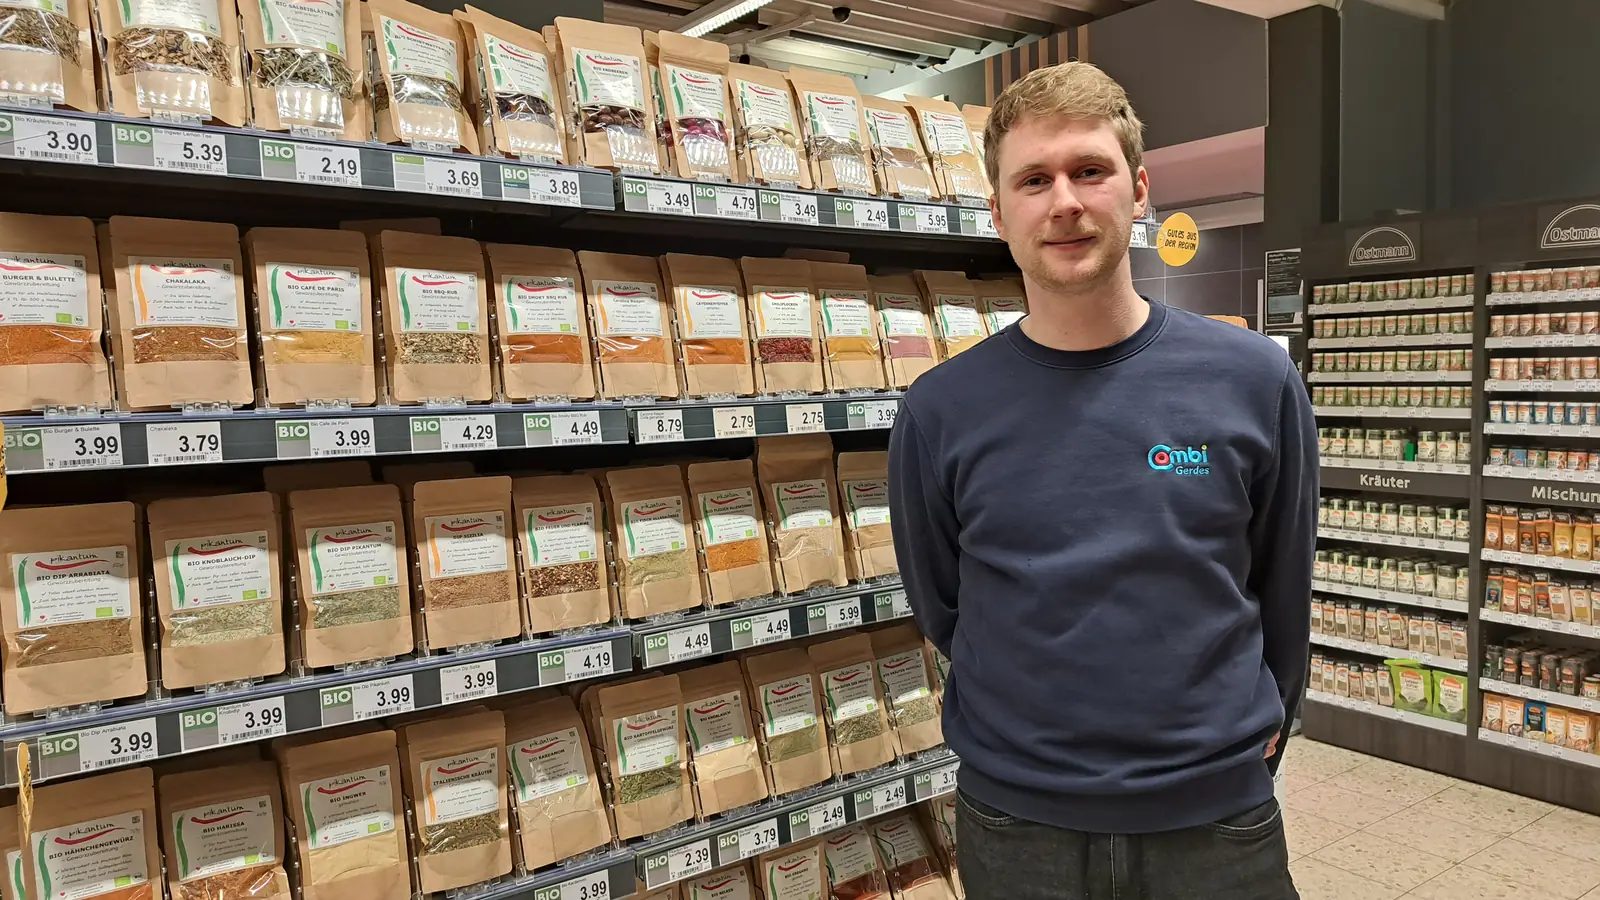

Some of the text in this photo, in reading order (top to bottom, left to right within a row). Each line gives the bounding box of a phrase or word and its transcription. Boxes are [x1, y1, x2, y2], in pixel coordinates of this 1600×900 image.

[48, 131, 92, 152] 3.90
[116, 128, 152, 143] BIO
[184, 142, 222, 162] 5.39
[264, 145, 294, 158] BIO
[322, 157, 357, 176] 2.19
[448, 170, 479, 187] 3.69
[504, 168, 528, 180] BIO
[550, 179, 578, 196] 3.89
[625, 184, 646, 194] BIO
[696, 187, 715, 198] BIO
[665, 192, 690, 207] 3.49
[732, 196, 755, 211] 4.79
[762, 194, 780, 204] BIO
[795, 203, 817, 217] 3.49
[836, 202, 853, 212] BIO
[900, 206, 915, 217] BIO
[867, 209, 886, 223] 2.49
[928, 214, 947, 228] 5.95
[962, 211, 976, 222] BIO
[1132, 230, 1146, 242] 3.19
[1550, 226, 1600, 242] Ostma
[1356, 245, 1410, 260] Ostmann
[802, 410, 824, 424] 2.75
[848, 405, 864, 416] BIO
[878, 408, 896, 421] 3.99
[413, 420, 440, 432] BIO
[526, 417, 550, 428] BIO
[570, 420, 598, 436] 4.49
[657, 418, 682, 432] 8.79
[731, 414, 754, 429] 2.79
[280, 426, 308, 438] BIO
[335, 430, 370, 447] 3.99
[463, 425, 494, 440] 4.29
[75, 436, 118, 456] 3.99
[179, 434, 218, 452] 3.79
[1148, 444, 1208, 470] Combi
[1175, 466, 1210, 476] Gerdes
[1360, 474, 1410, 490] Kräuter
[200, 538, 244, 549] pikantum
[50, 554, 98, 564] pikantum
[202, 554, 256, 565] KNOBLAUCH-DIP
[36, 574, 51, 582] BIO
[69, 570, 110, 579] ARRABIATA
[876, 596, 892, 606] BIO
[808, 607, 826, 618] BIO
[840, 606, 860, 620] 5.99
[732, 621, 752, 633] BIO
[766, 618, 789, 634] 4.49
[647, 636, 668, 649] BIO
[684, 632, 710, 649] 4.49
[540, 654, 564, 666] BIO
[583, 652, 611, 669] 4.19
[464, 671, 494, 690] 3.99
[323, 690, 351, 705] BIO
[378, 686, 410, 706] 3.99
[185, 712, 216, 728] BIO
[245, 708, 282, 728] 3.99
[42, 738, 78, 756] BIO
[110, 731, 152, 755] 3.99
[916, 774, 930, 784] BIO
[944, 770, 958, 784] 3.7
[856, 792, 872, 803] BIO
[886, 786, 904, 802] 2.49
[204, 806, 244, 818] pikantum
[823, 806, 843, 823] 2.49
[217, 821, 245, 832] HARISSA
[792, 814, 808, 825] BIO
[69, 822, 116, 839] pikantum
[755, 828, 776, 846] 3.79
[49, 836, 134, 860] BIO HÄHNCHENGEWÜRZ
[720, 836, 738, 848] BIO
[648, 856, 668, 869] BIO
[686, 848, 709, 867] 2.39
[537, 888, 560, 900] BIO
[580, 881, 607, 900] 3.99
